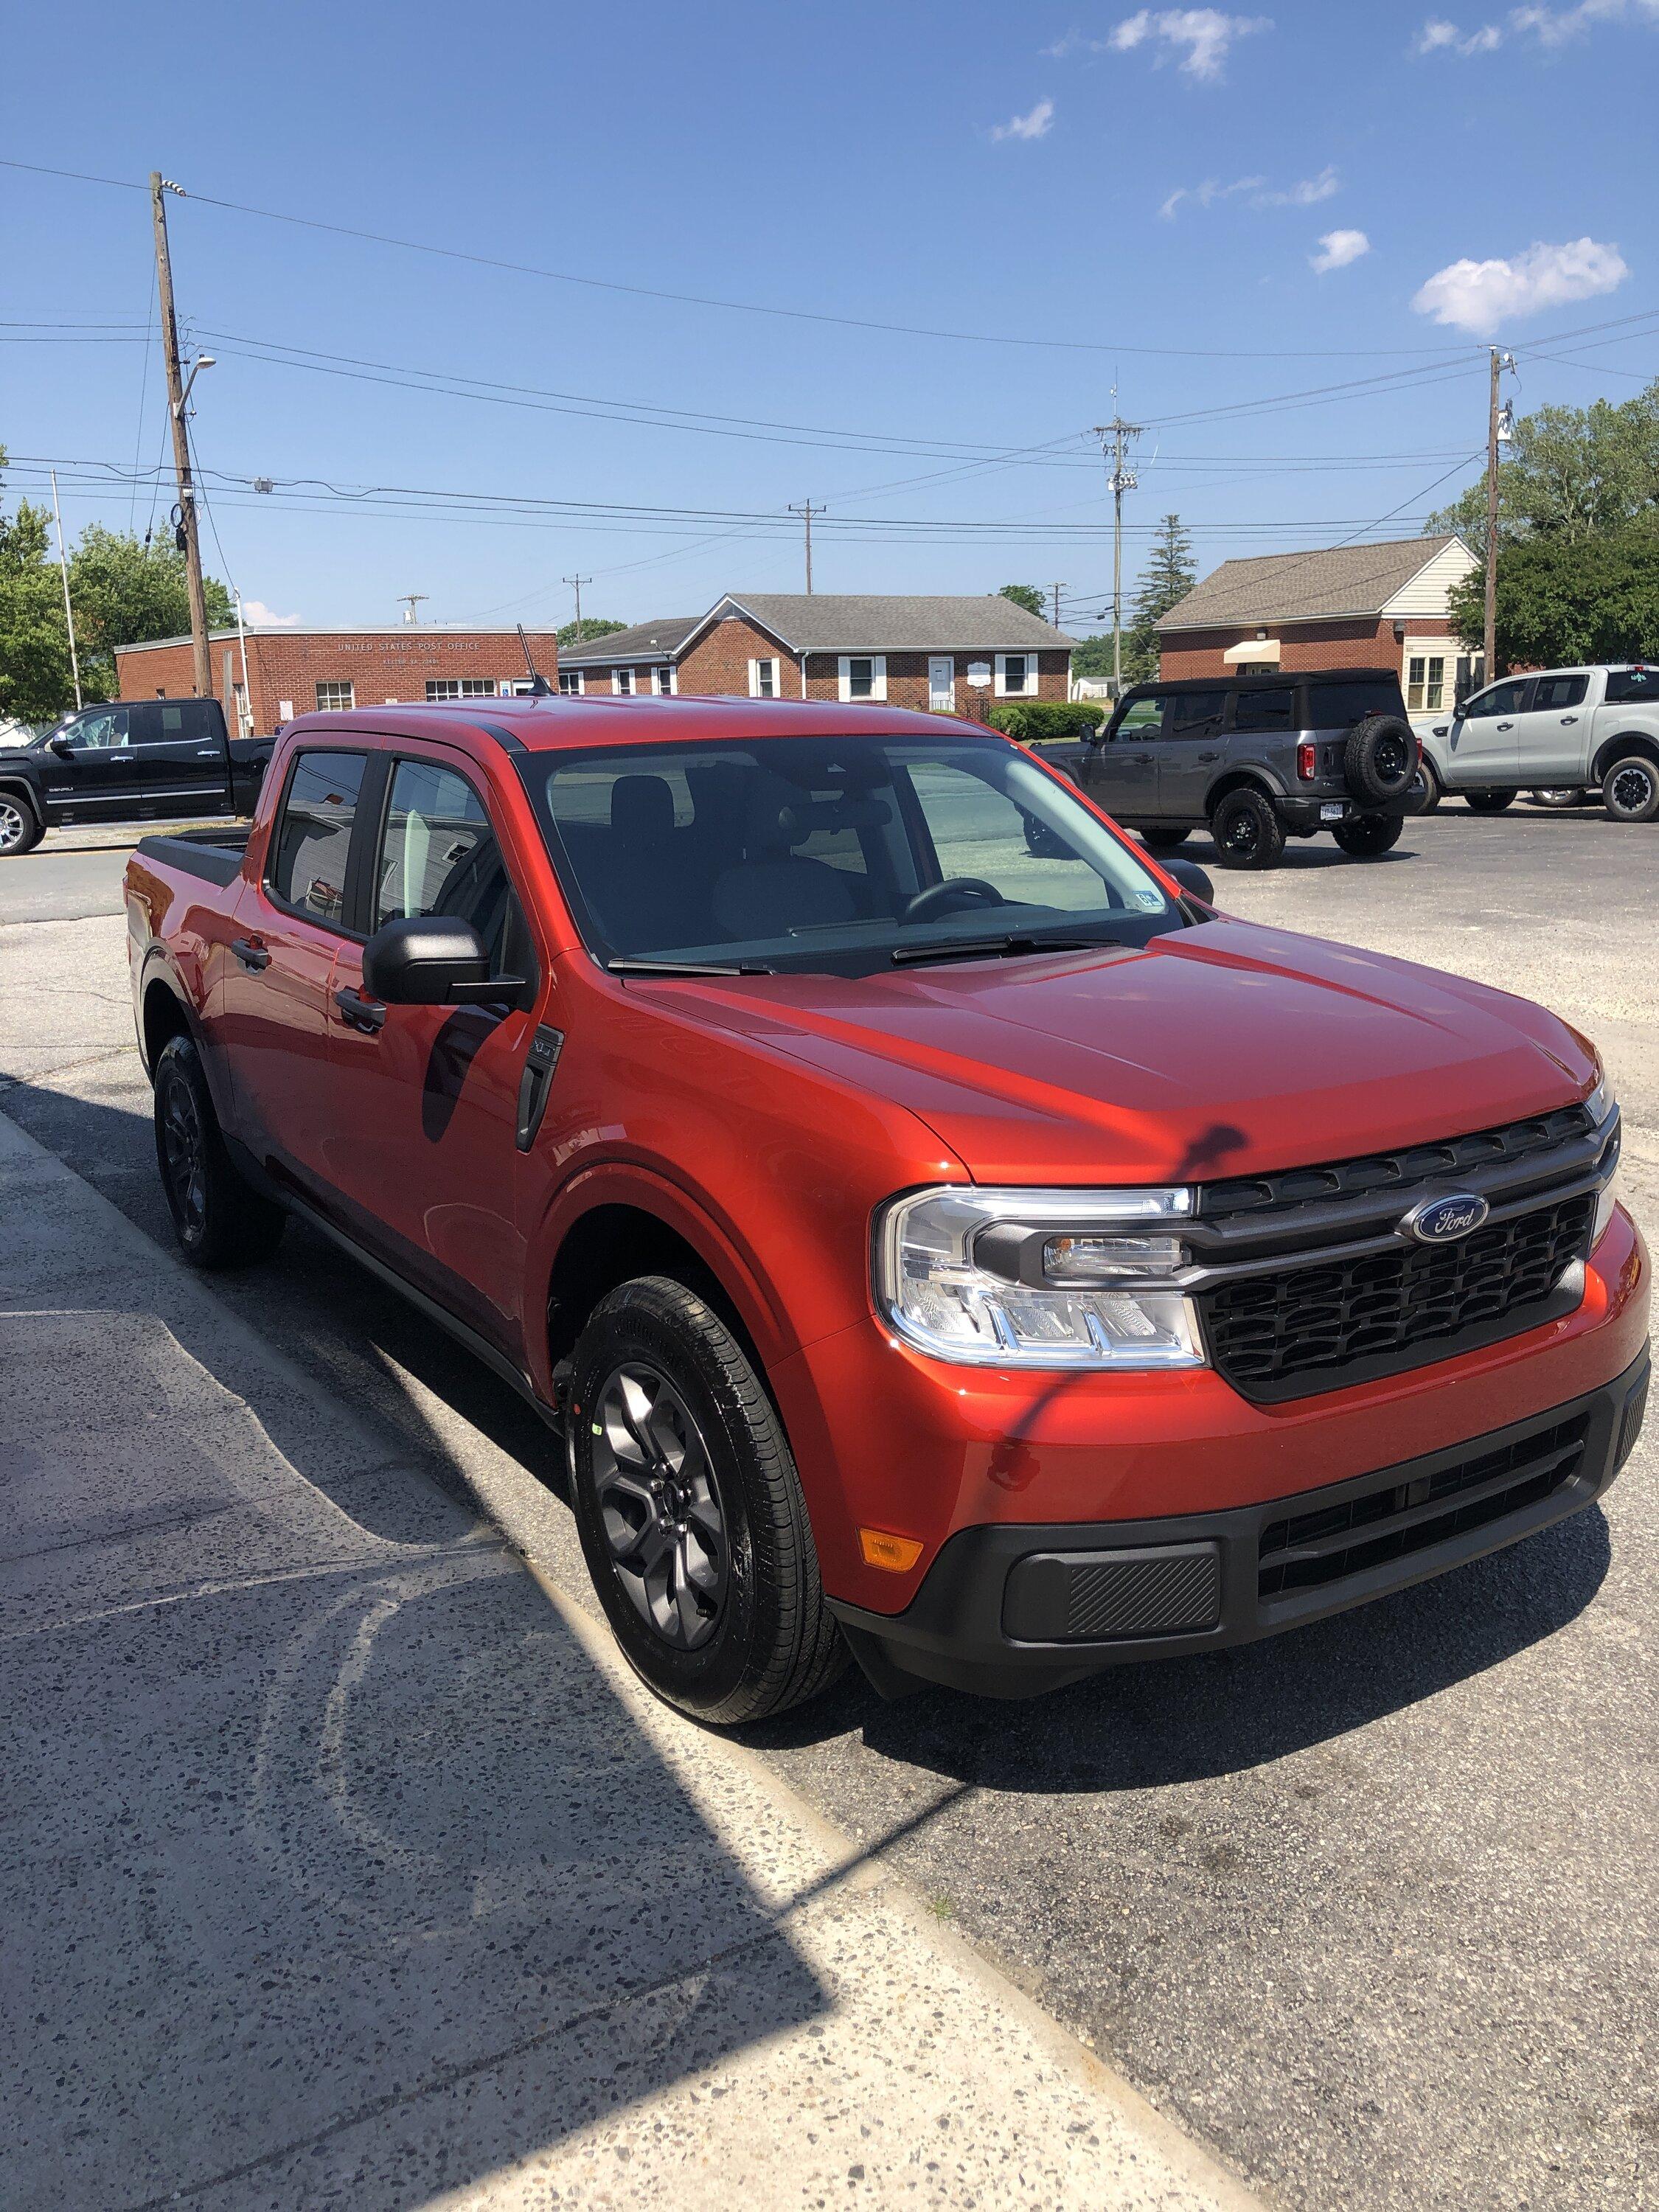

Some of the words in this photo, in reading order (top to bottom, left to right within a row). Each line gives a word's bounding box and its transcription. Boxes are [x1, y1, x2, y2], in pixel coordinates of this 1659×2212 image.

[338, 643, 373, 652] UNITED
[378, 642, 413, 652] STATES
[418, 642, 442, 651] POST
[447, 642, 480, 651] OFFICE
[1434, 1204, 1475, 1234] Ford
